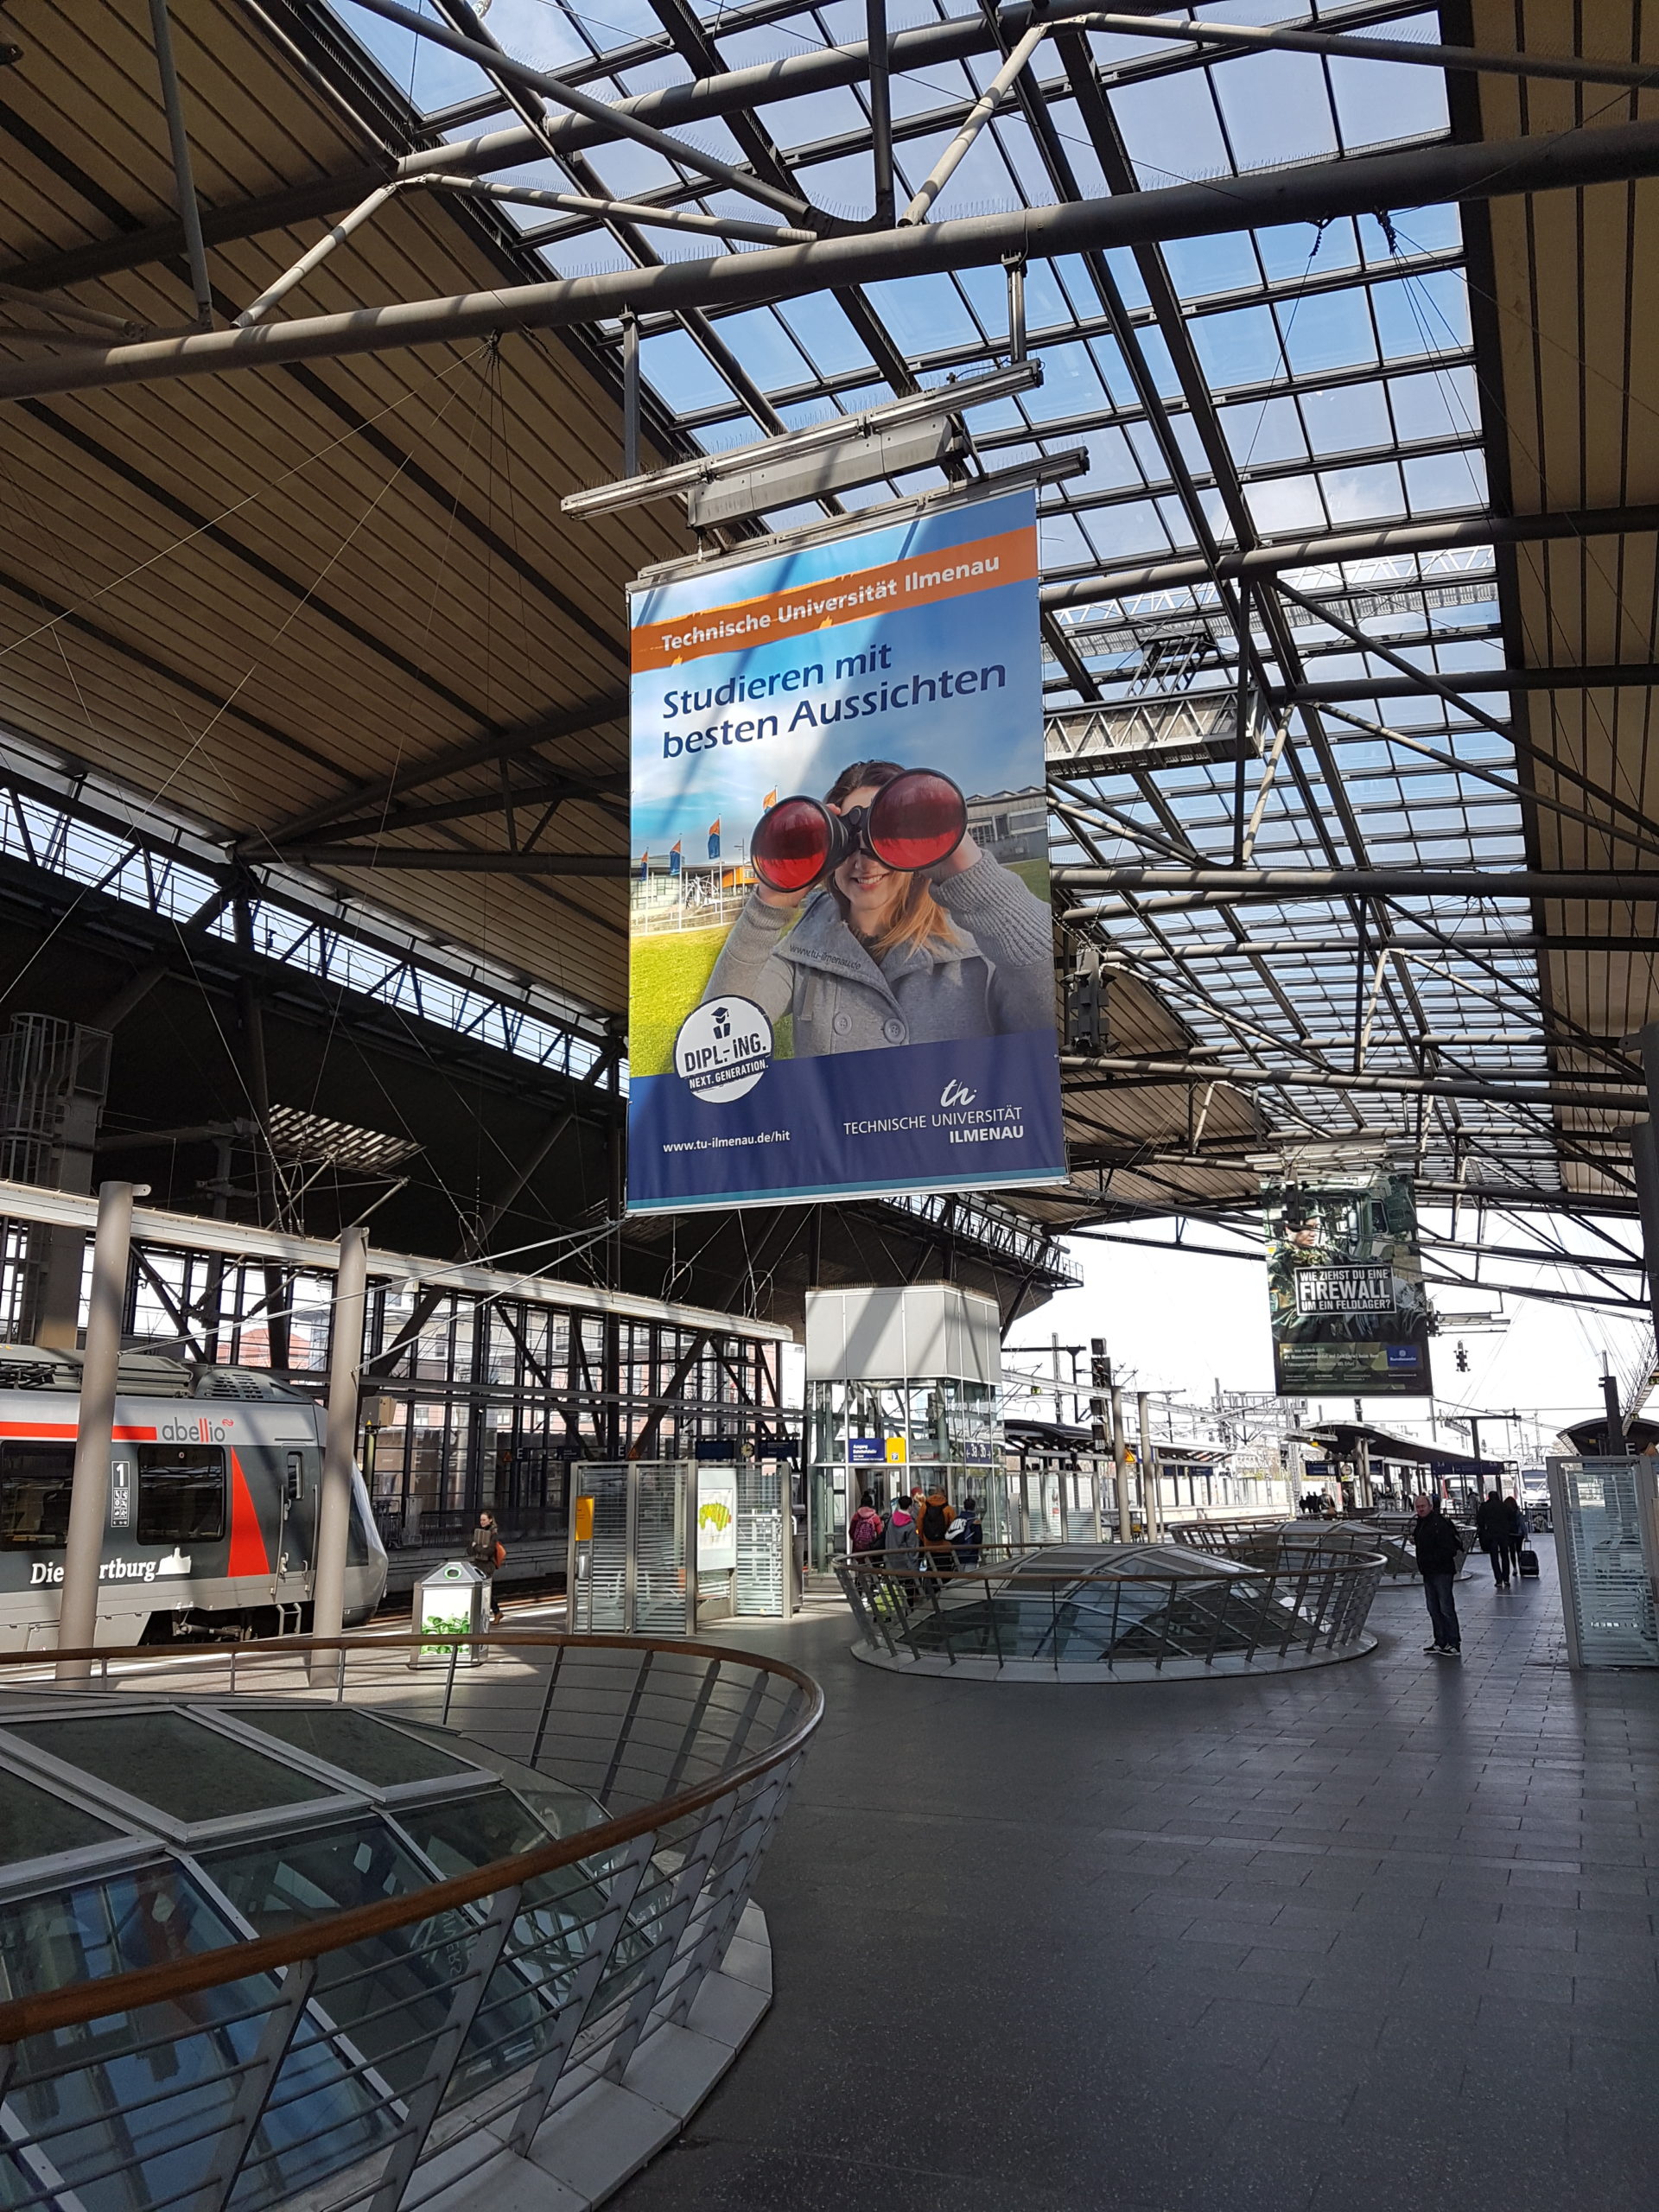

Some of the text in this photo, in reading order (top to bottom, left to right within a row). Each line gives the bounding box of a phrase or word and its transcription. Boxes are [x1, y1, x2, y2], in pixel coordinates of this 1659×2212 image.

[661, 556, 1001, 652] Technische Universität Ilmenau
[662, 643, 893, 719] Studieren mit
[662, 663, 1007, 759] besten Aussichten
[789, 944, 861, 970] www.tu-ilmenau.de
[689, 1059, 769, 1089] NEXT. GENERATION.
[843, 1104, 1023, 1135] TECHNISCHE UNIVERSITÄT
[663, 1130, 791, 1154] www.tu-ilmenau.de/hit
[950, 1125, 1024, 1143] ILMENAU
[1300, 1269, 1389, 1281] WIE ZIEHST DU EINE
[1300, 1280, 1390, 1300] FIREWALL
[1301, 1299, 1391, 1311] UM EIN FELDLAGER?
[162, 1416, 226, 1443] abellio
[116, 1463, 124, 1487] 1
[30, 1558, 157, 1585] Die rtburg
